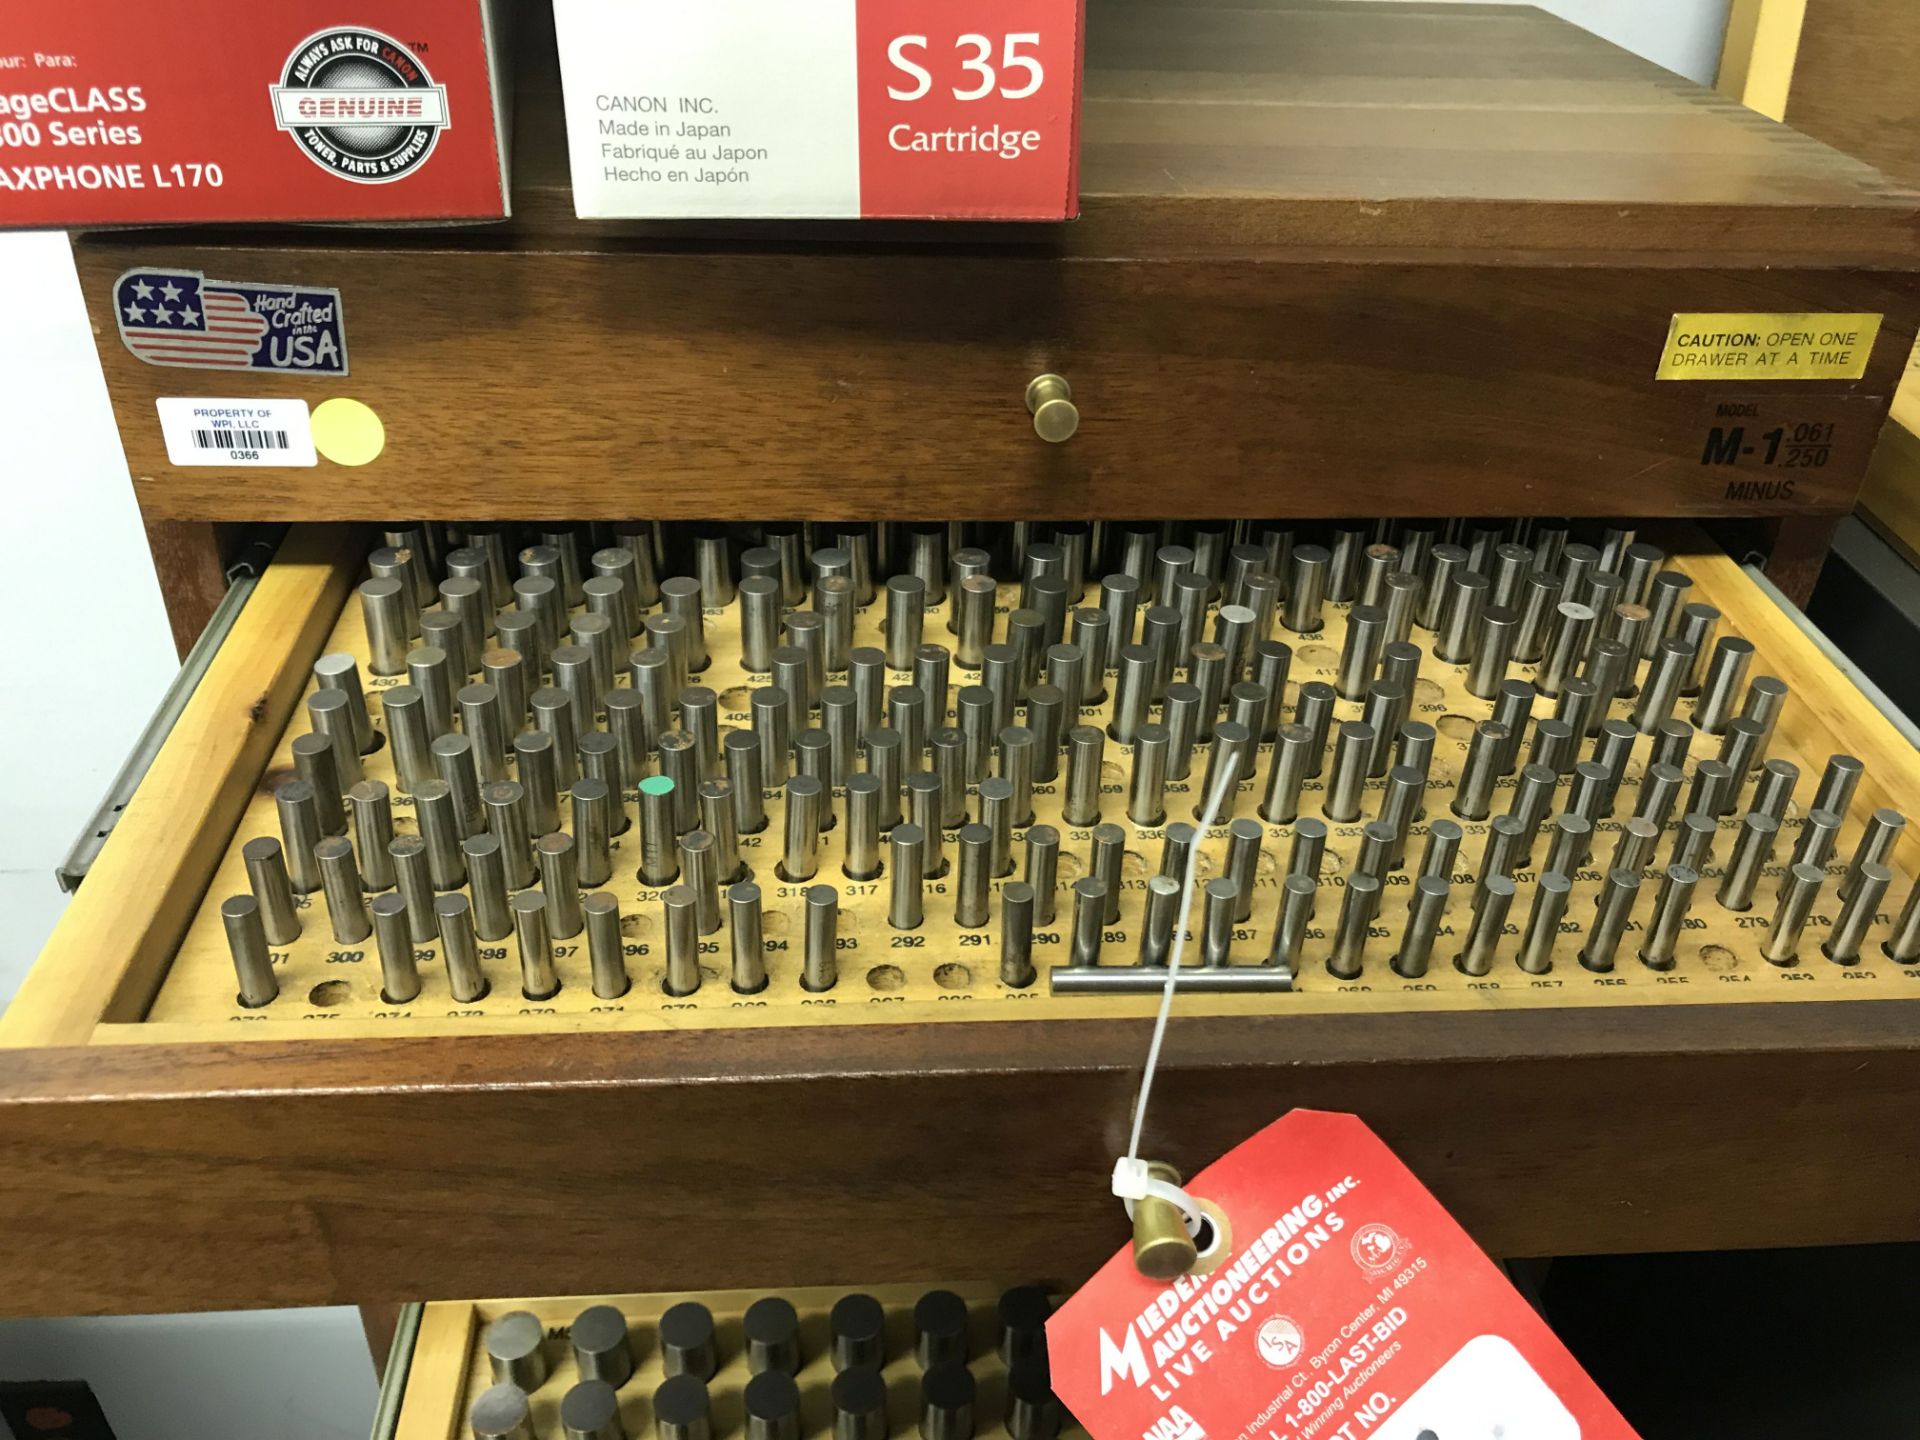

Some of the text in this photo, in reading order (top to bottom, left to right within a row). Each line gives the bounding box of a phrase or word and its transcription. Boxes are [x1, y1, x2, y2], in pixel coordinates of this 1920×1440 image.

[34, 52, 78, 68] Para:
[294, 37, 419, 82] ALWAYS ASK FOR CANON
[886, 32, 1045, 101] S 35
[298, 96, 423, 119] GENUINE
[595, 94, 719, 114] CANON INC.
[0, 119, 142, 148] 00 Series
[598, 119, 732, 141] Made in Japan
[304, 129, 428, 174] TONER, PARTS & SUPPLIES
[888, 124, 1041, 159] Cartridge
[601, 142, 769, 164] Fabriqué au Japon
[154, 163, 224, 189] L170
[604, 165, 750, 186] Hecho en Japón
[253, 291, 297, 313] Hand
[271, 301, 334, 329] Crafted
[269, 329, 340, 368] USA
[1677, 332, 1859, 348] CAUTION: OPEN ONE
[1671, 351, 1852, 367] DRAWER AT A TIME
[193, 408, 273, 418] PROPERTY OF
[1716, 404, 1760, 417] MODEL
[237, 420, 260, 429] LLC
[230, 450, 260, 460] 0366
[1701, 426, 1784, 466] M-1
[1725, 481, 1796, 501] MINUS
[368, 678, 398, 687] 430
[1418, 703, 1447, 712] 396
[1426, 780, 1455, 789] 354
[846, 884, 878, 896] 317
[1735, 917, 1770, 929] 279
[891, 936, 925, 949] 292
[959, 935, 991, 947] 291
[325, 951, 364, 964] 300
[1152, 1175, 1361, 1368] AUCTIONEERING, INC.
[1150, 1211, 1345, 1402] LIVE AUCTIONS
[1245, 1384, 1294, 1435] Industrial
[1309, 1338, 1343, 1369] Byron
[1340, 1303, 1381, 1338] Center,
[1376, 1287, 1394, 1305] MI
[1392, 1256, 1428, 1290] 49315
[1260, 1335, 1298, 1355] ISA
[1285, 1307, 1408, 1429] 1-800-LAST-BID
[1300, 1341, 1402, 1440] Winning Auctioneers
[1354, 1391, 1397, 1429] NO.
